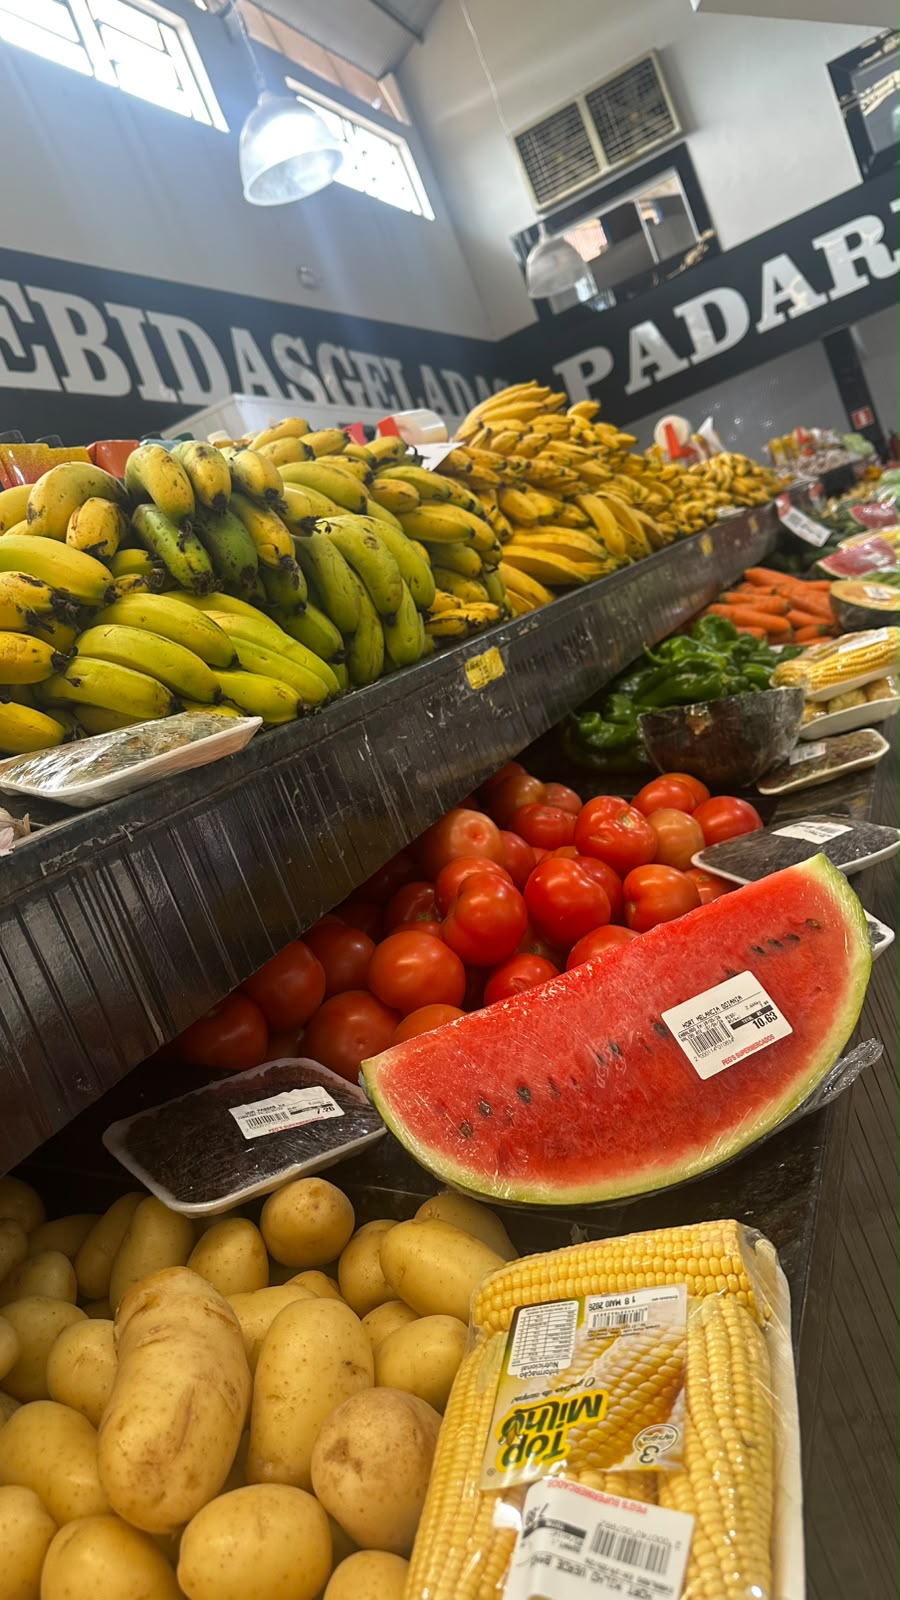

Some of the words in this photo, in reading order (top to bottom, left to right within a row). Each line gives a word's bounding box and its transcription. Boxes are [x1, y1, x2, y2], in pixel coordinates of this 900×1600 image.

[553, 197, 900, 405] PADAR
[681, 1019, 694, 1028] HORT
[695, 1006, 720, 1021] MELANCIA
[752, 1011, 778, 1030] 10.63
[734, 1034, 775, 1058] SUPERMERCADOS
[605, 1299, 620, 1307] MAIO
[519, 1367, 559, 1378] Informação
[520, 1361, 559, 1371] Nutricional
[501, 1394, 603, 1434] Milho
[502, 1432, 564, 1467] Top
[640, 1446, 659, 1464] 3
